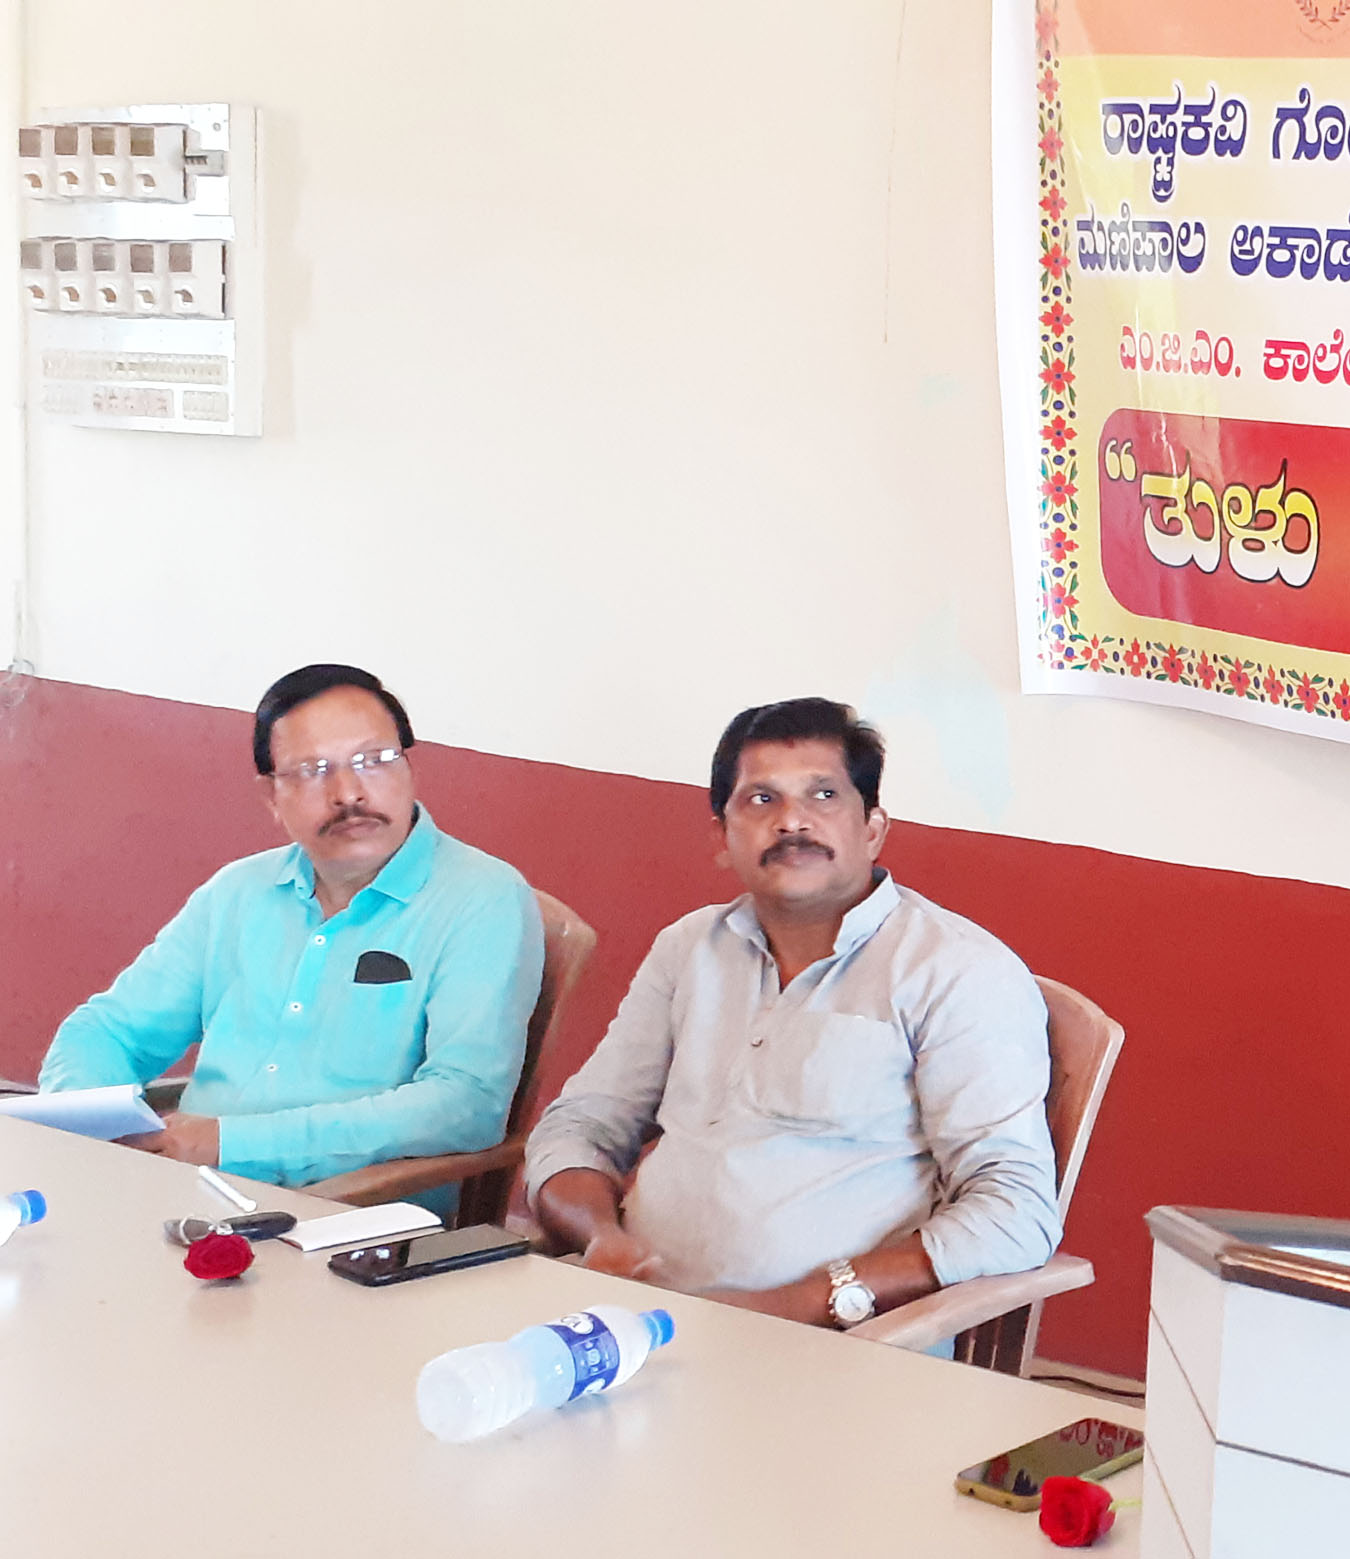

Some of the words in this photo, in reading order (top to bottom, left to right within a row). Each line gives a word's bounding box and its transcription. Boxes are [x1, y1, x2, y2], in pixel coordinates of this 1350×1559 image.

[1101, 84, 1248, 203] ರಾಷ್ಟ್ರಕವಿ
[1076, 202, 1206, 274] ಮಣಿಪಾಲ
[1120, 325, 1242, 378] ಎಂ.ಜಿ.ಎಂ.
